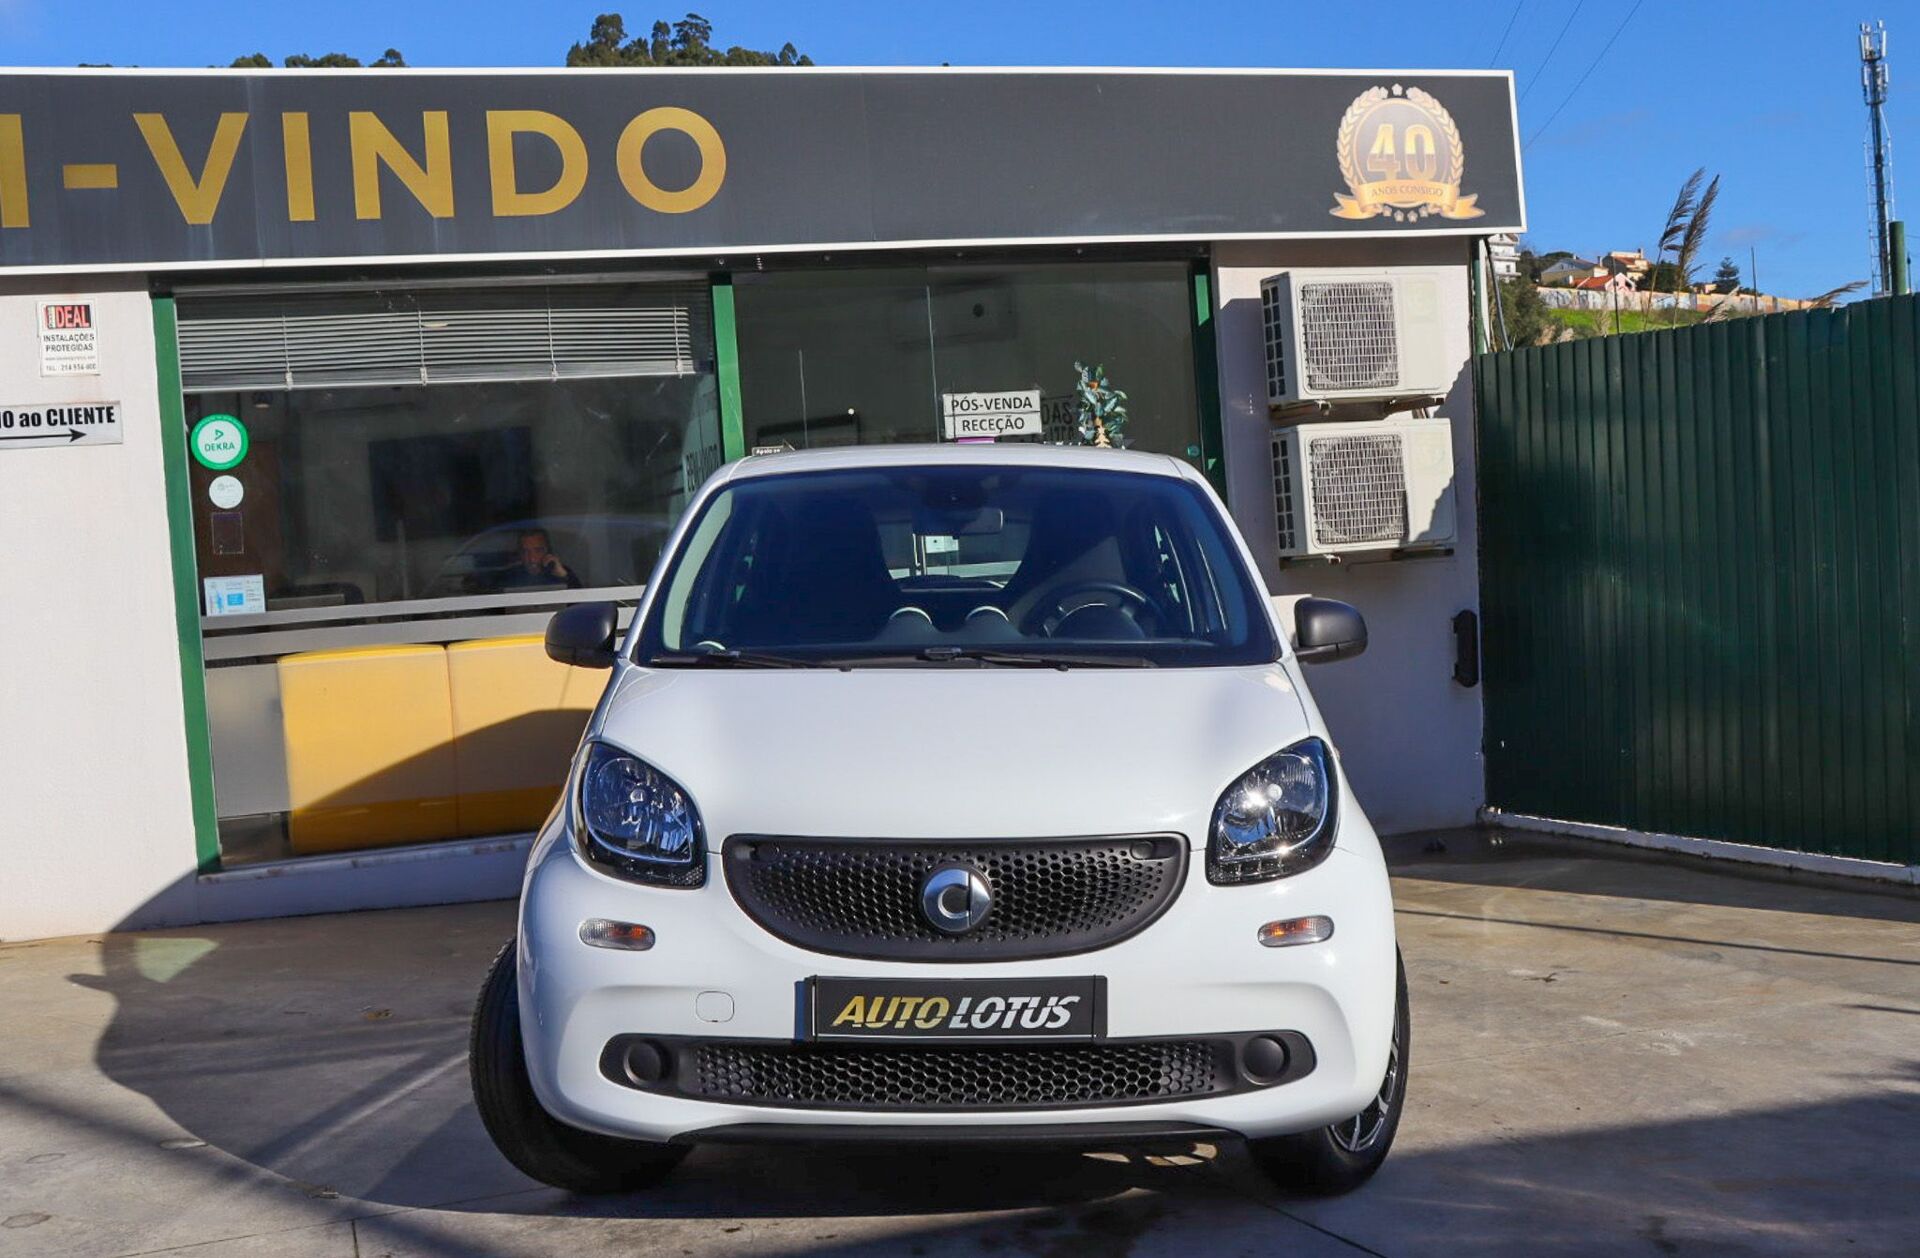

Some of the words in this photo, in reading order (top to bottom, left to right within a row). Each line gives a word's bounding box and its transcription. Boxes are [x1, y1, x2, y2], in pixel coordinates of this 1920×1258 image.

[1366, 123, 1437, 181] 40
[45, 343, 94, 352] PROTEGIDAS
[952, 396, 1033, 412] PÓS-VENDA
[19, 412, 42, 428] ao
[46, 406, 115, 427] CLIENTE
[962, 415, 1025, 434] RECEÇÃO
[204, 442, 235, 452] DEKRA
[831, 995, 949, 1029] AUTO
[949, 995, 1080, 1029] LOTUS
